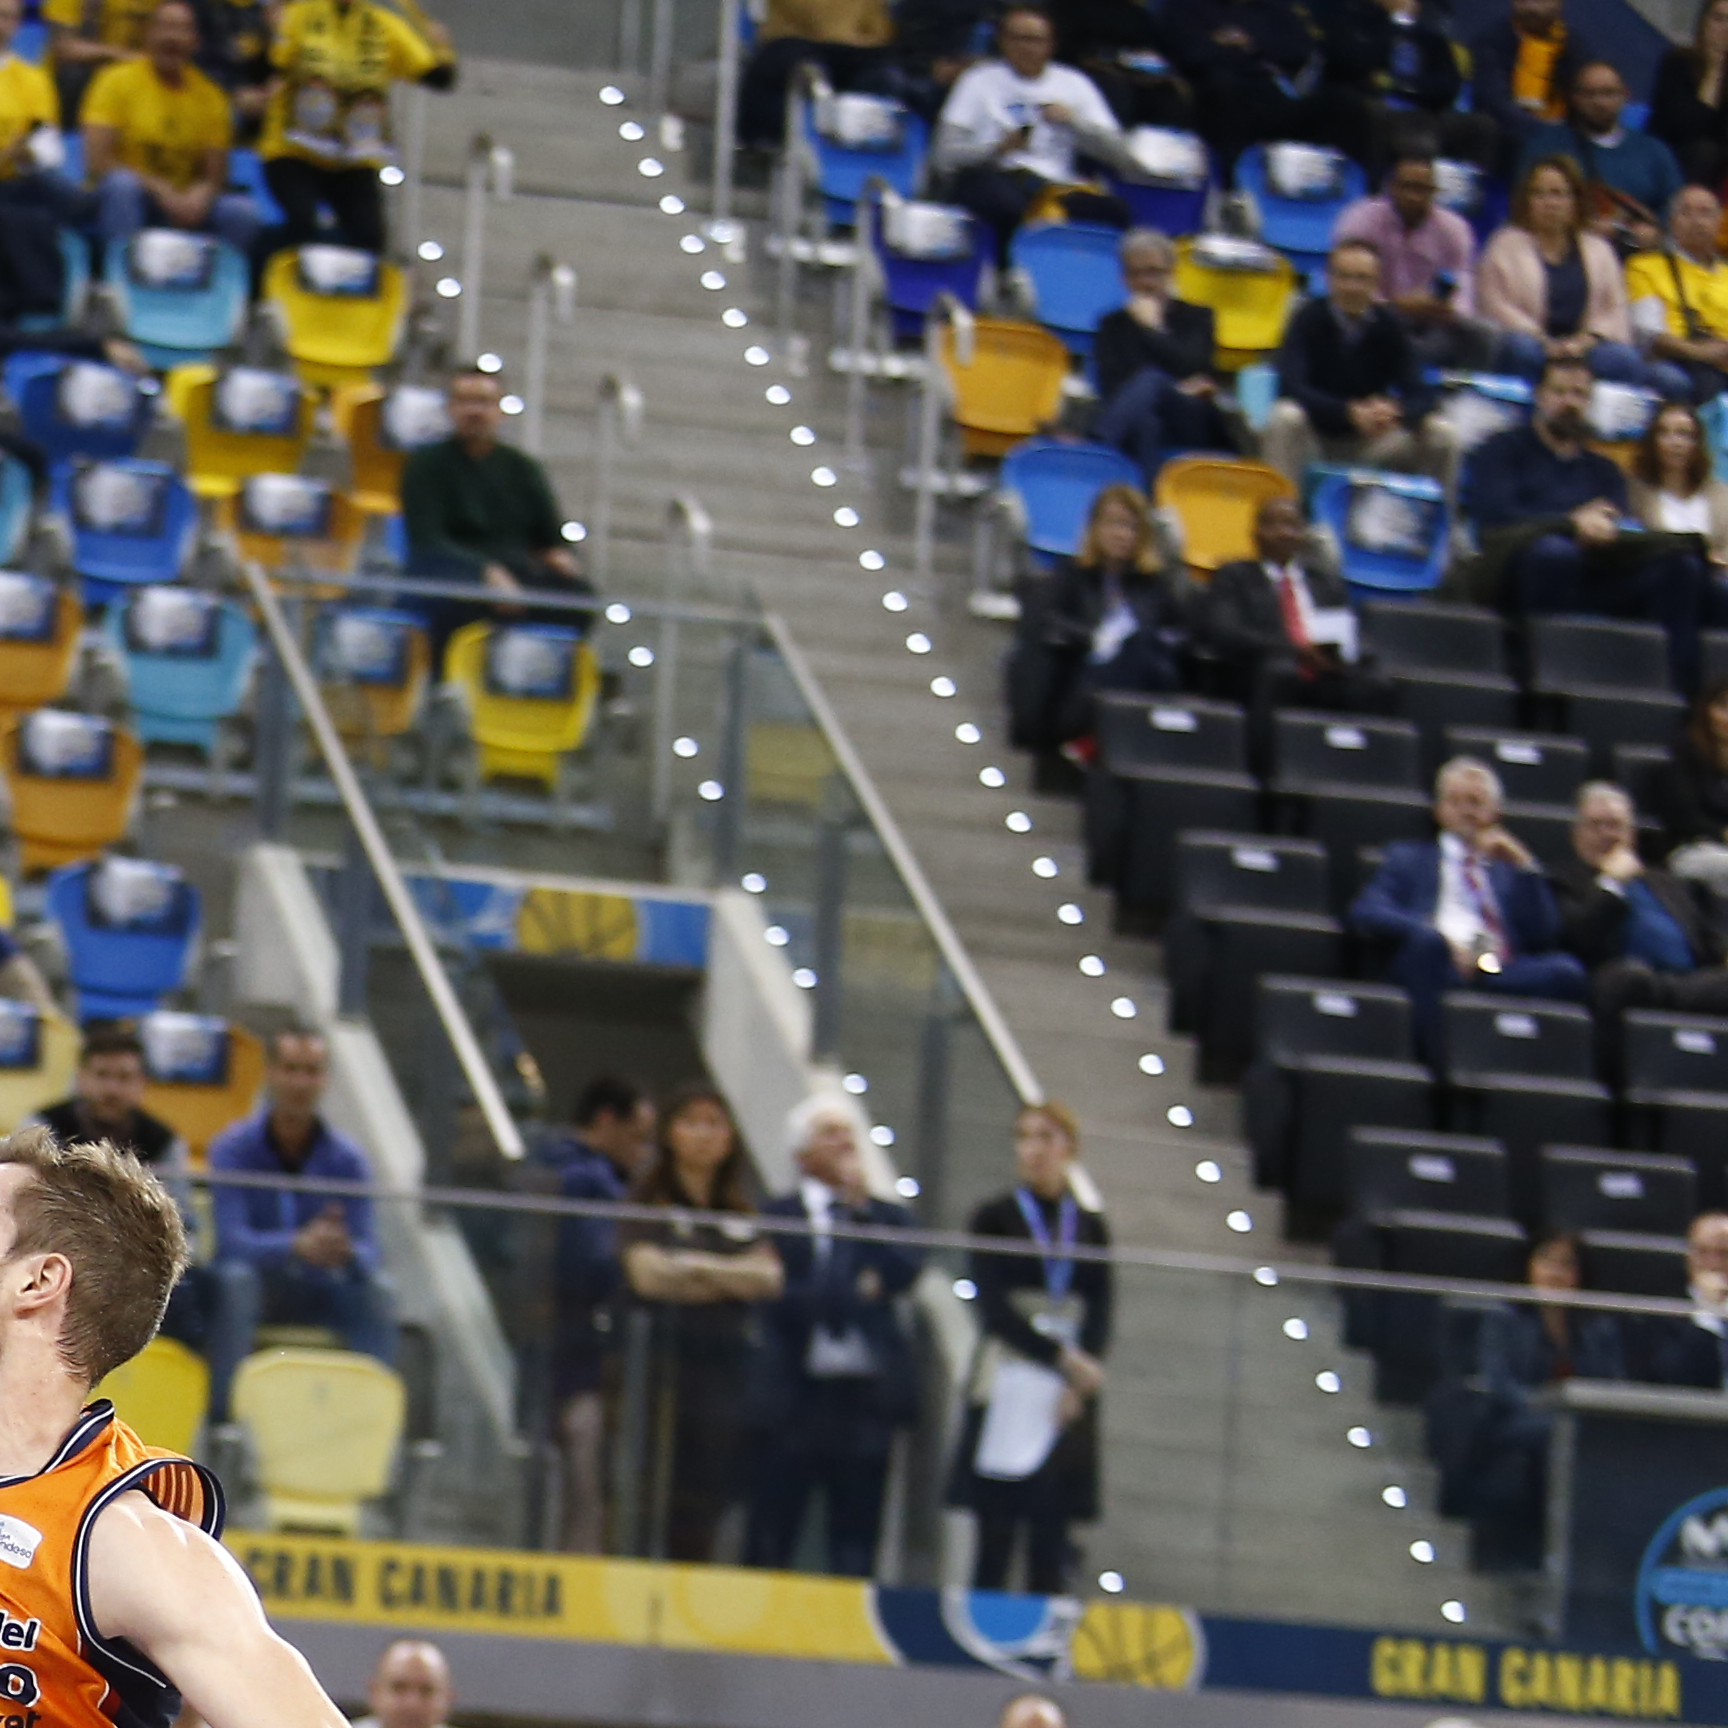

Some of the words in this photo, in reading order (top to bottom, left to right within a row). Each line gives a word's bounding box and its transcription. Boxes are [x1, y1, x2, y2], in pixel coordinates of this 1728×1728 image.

[381, 1558, 563, 1618] CANARIA
[1371, 1636, 1488, 1703] GRAN
[1498, 1647, 1682, 1718] CANARIA
